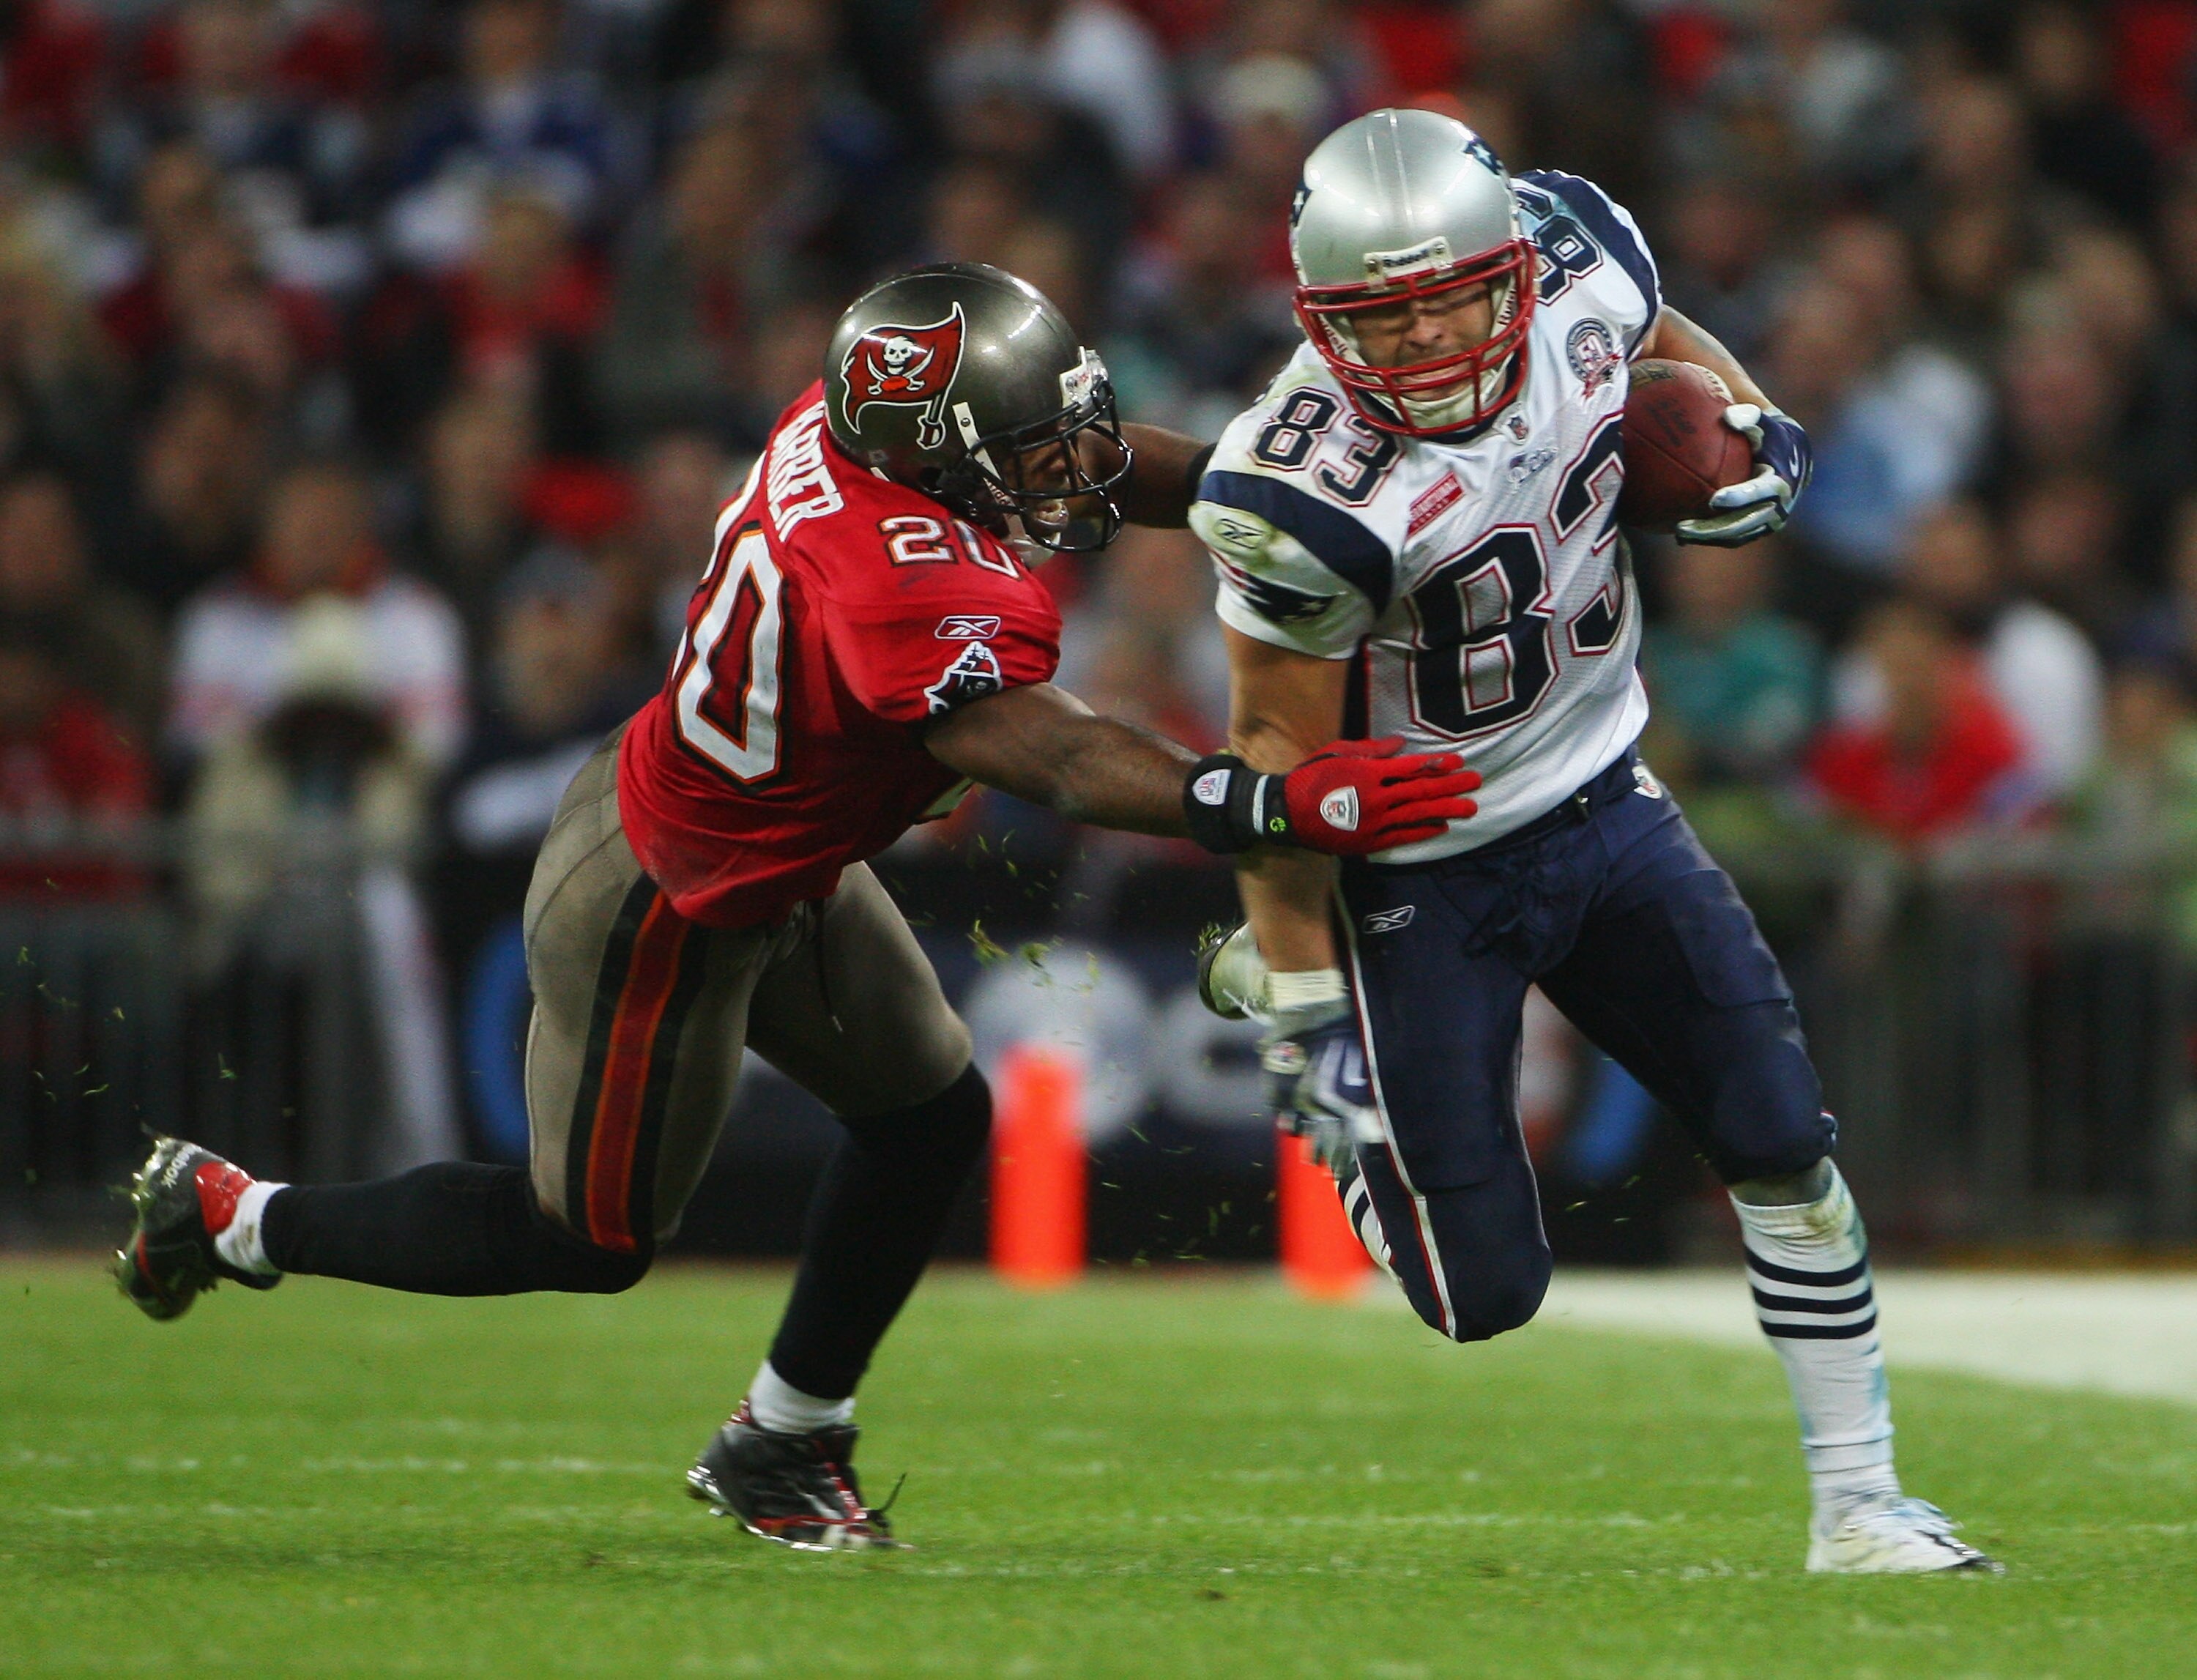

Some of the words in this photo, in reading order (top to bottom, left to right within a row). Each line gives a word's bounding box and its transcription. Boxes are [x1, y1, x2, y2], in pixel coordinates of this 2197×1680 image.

[767, 399, 845, 543] ARBER
[1247, 386, 1407, 508] 83
[672, 450, 789, 789] 0
[1403, 407, 1626, 743] 83
